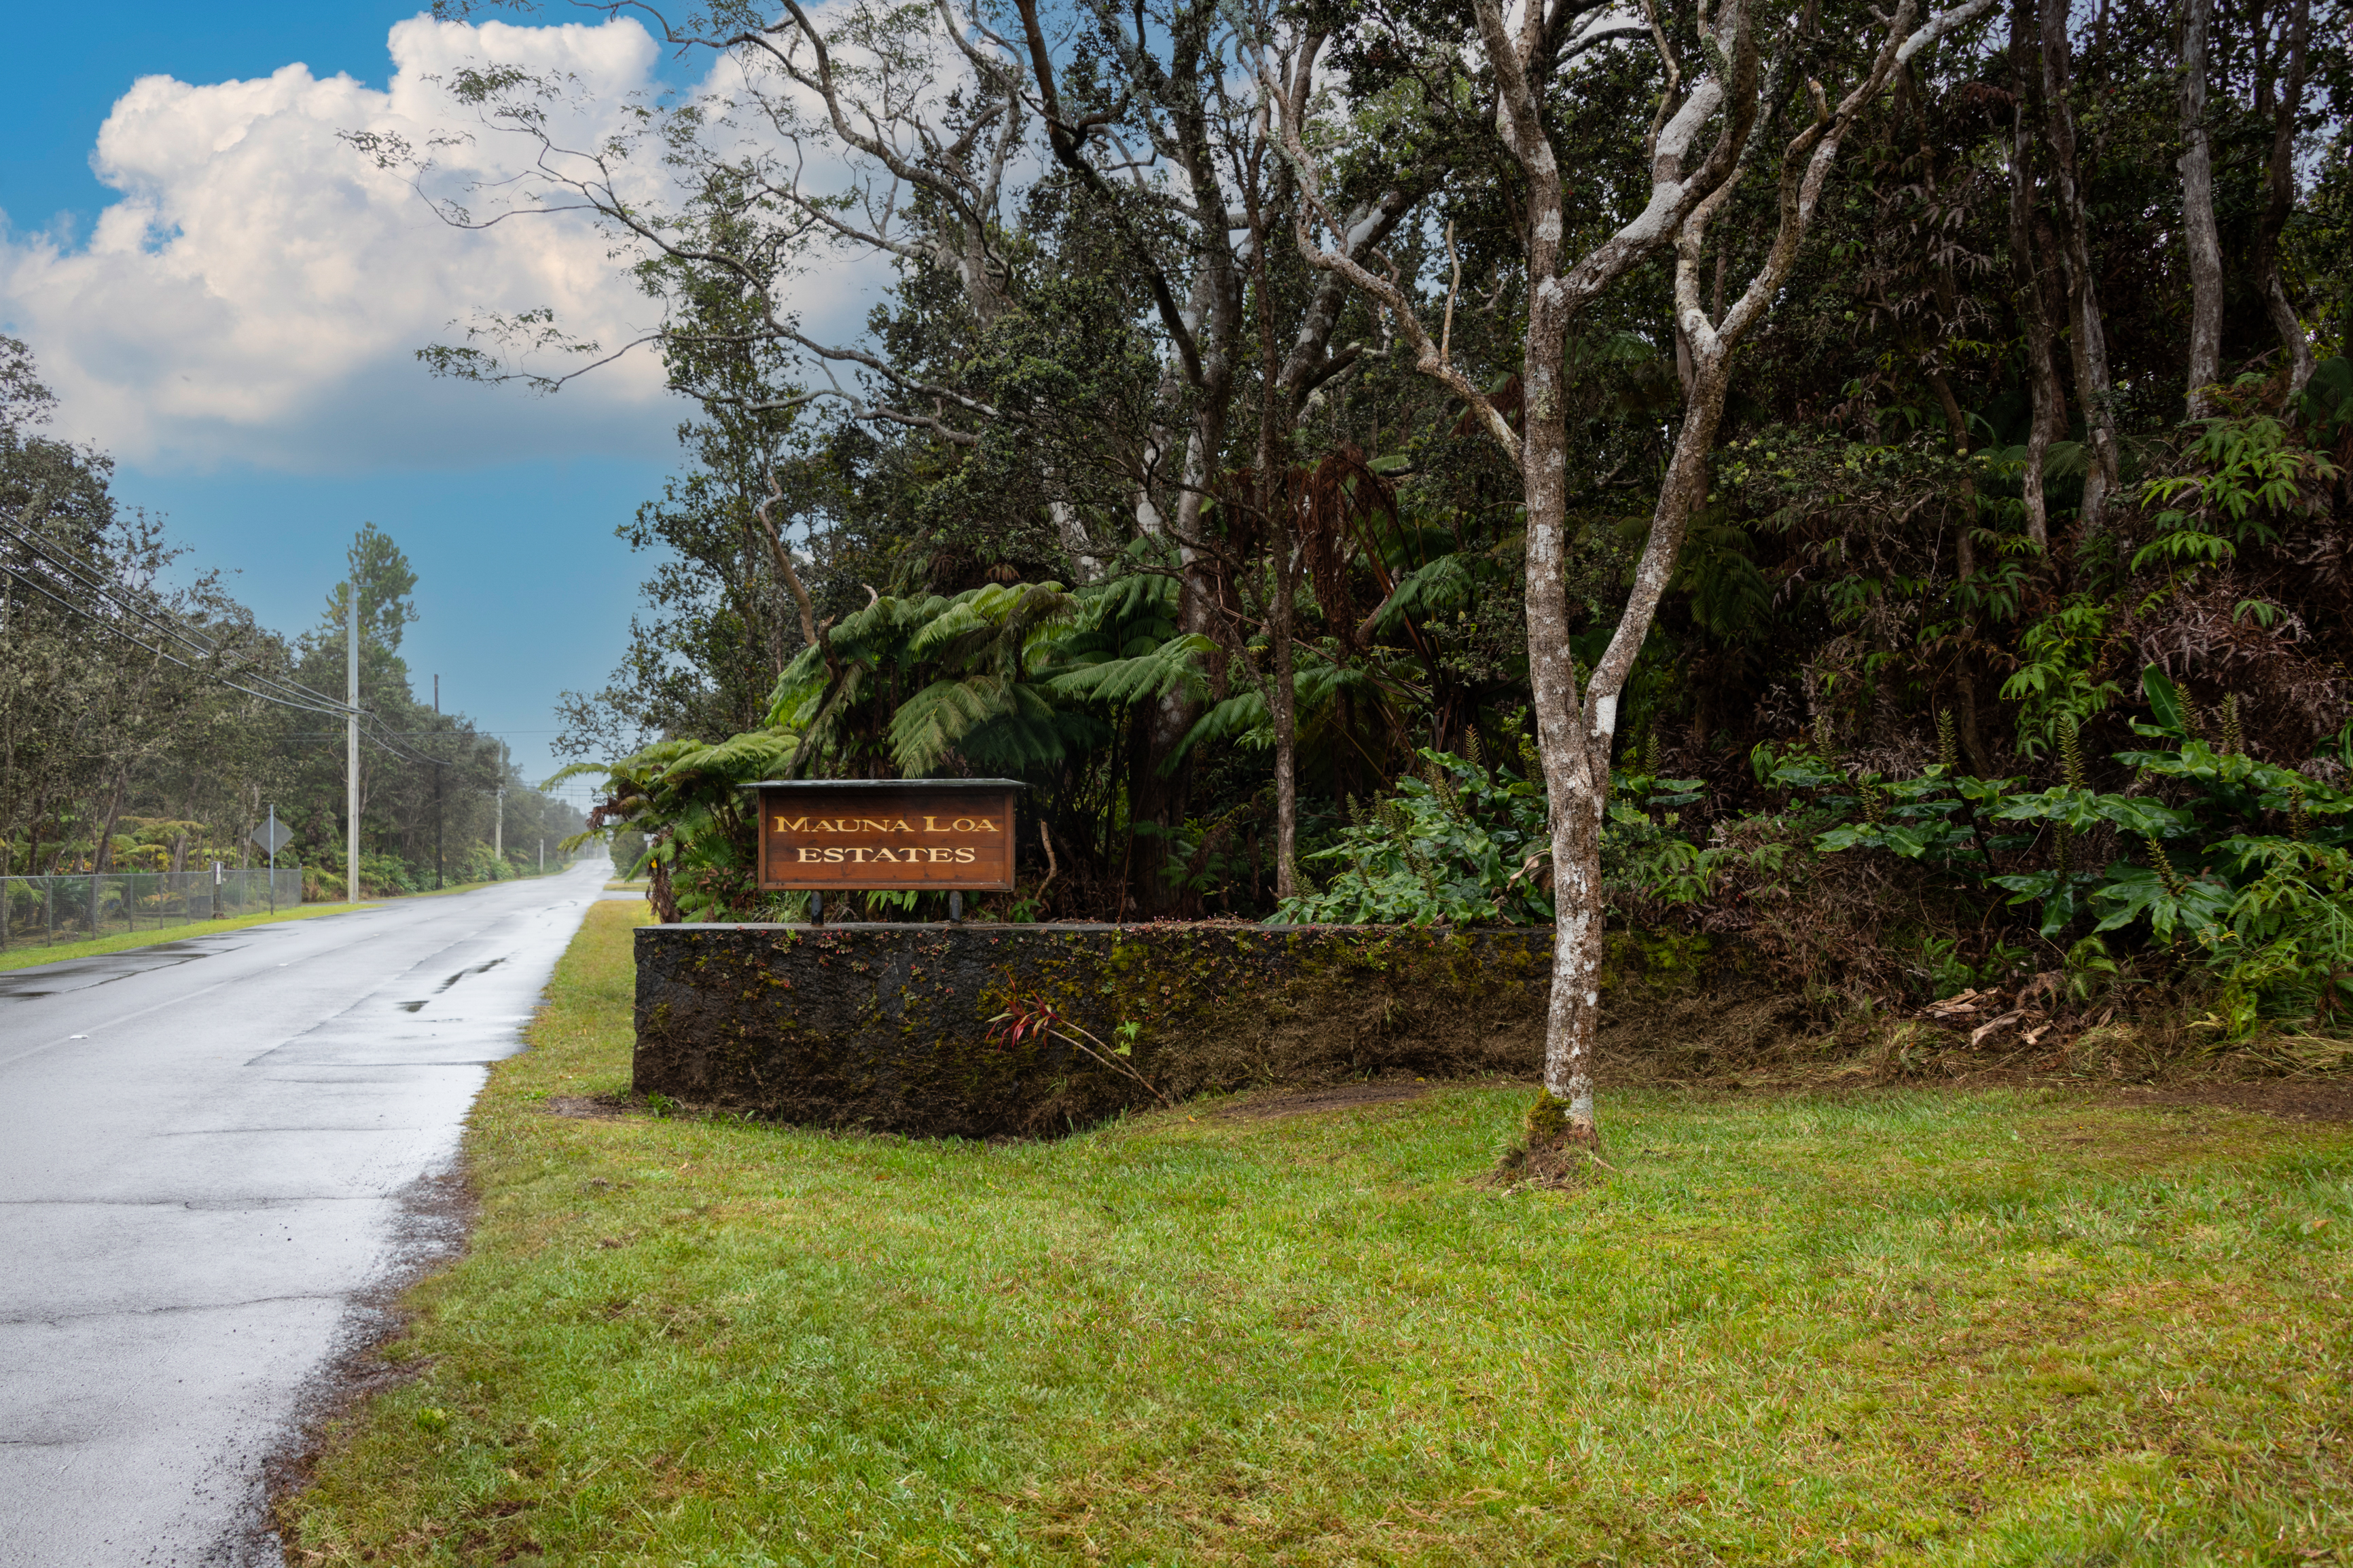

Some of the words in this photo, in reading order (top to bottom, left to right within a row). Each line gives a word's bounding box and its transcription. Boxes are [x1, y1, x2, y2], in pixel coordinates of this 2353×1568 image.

[773, 816, 915, 833] MAUNA
[922, 816, 1000, 833] LOA
[796, 847, 976, 863] ESTATES
